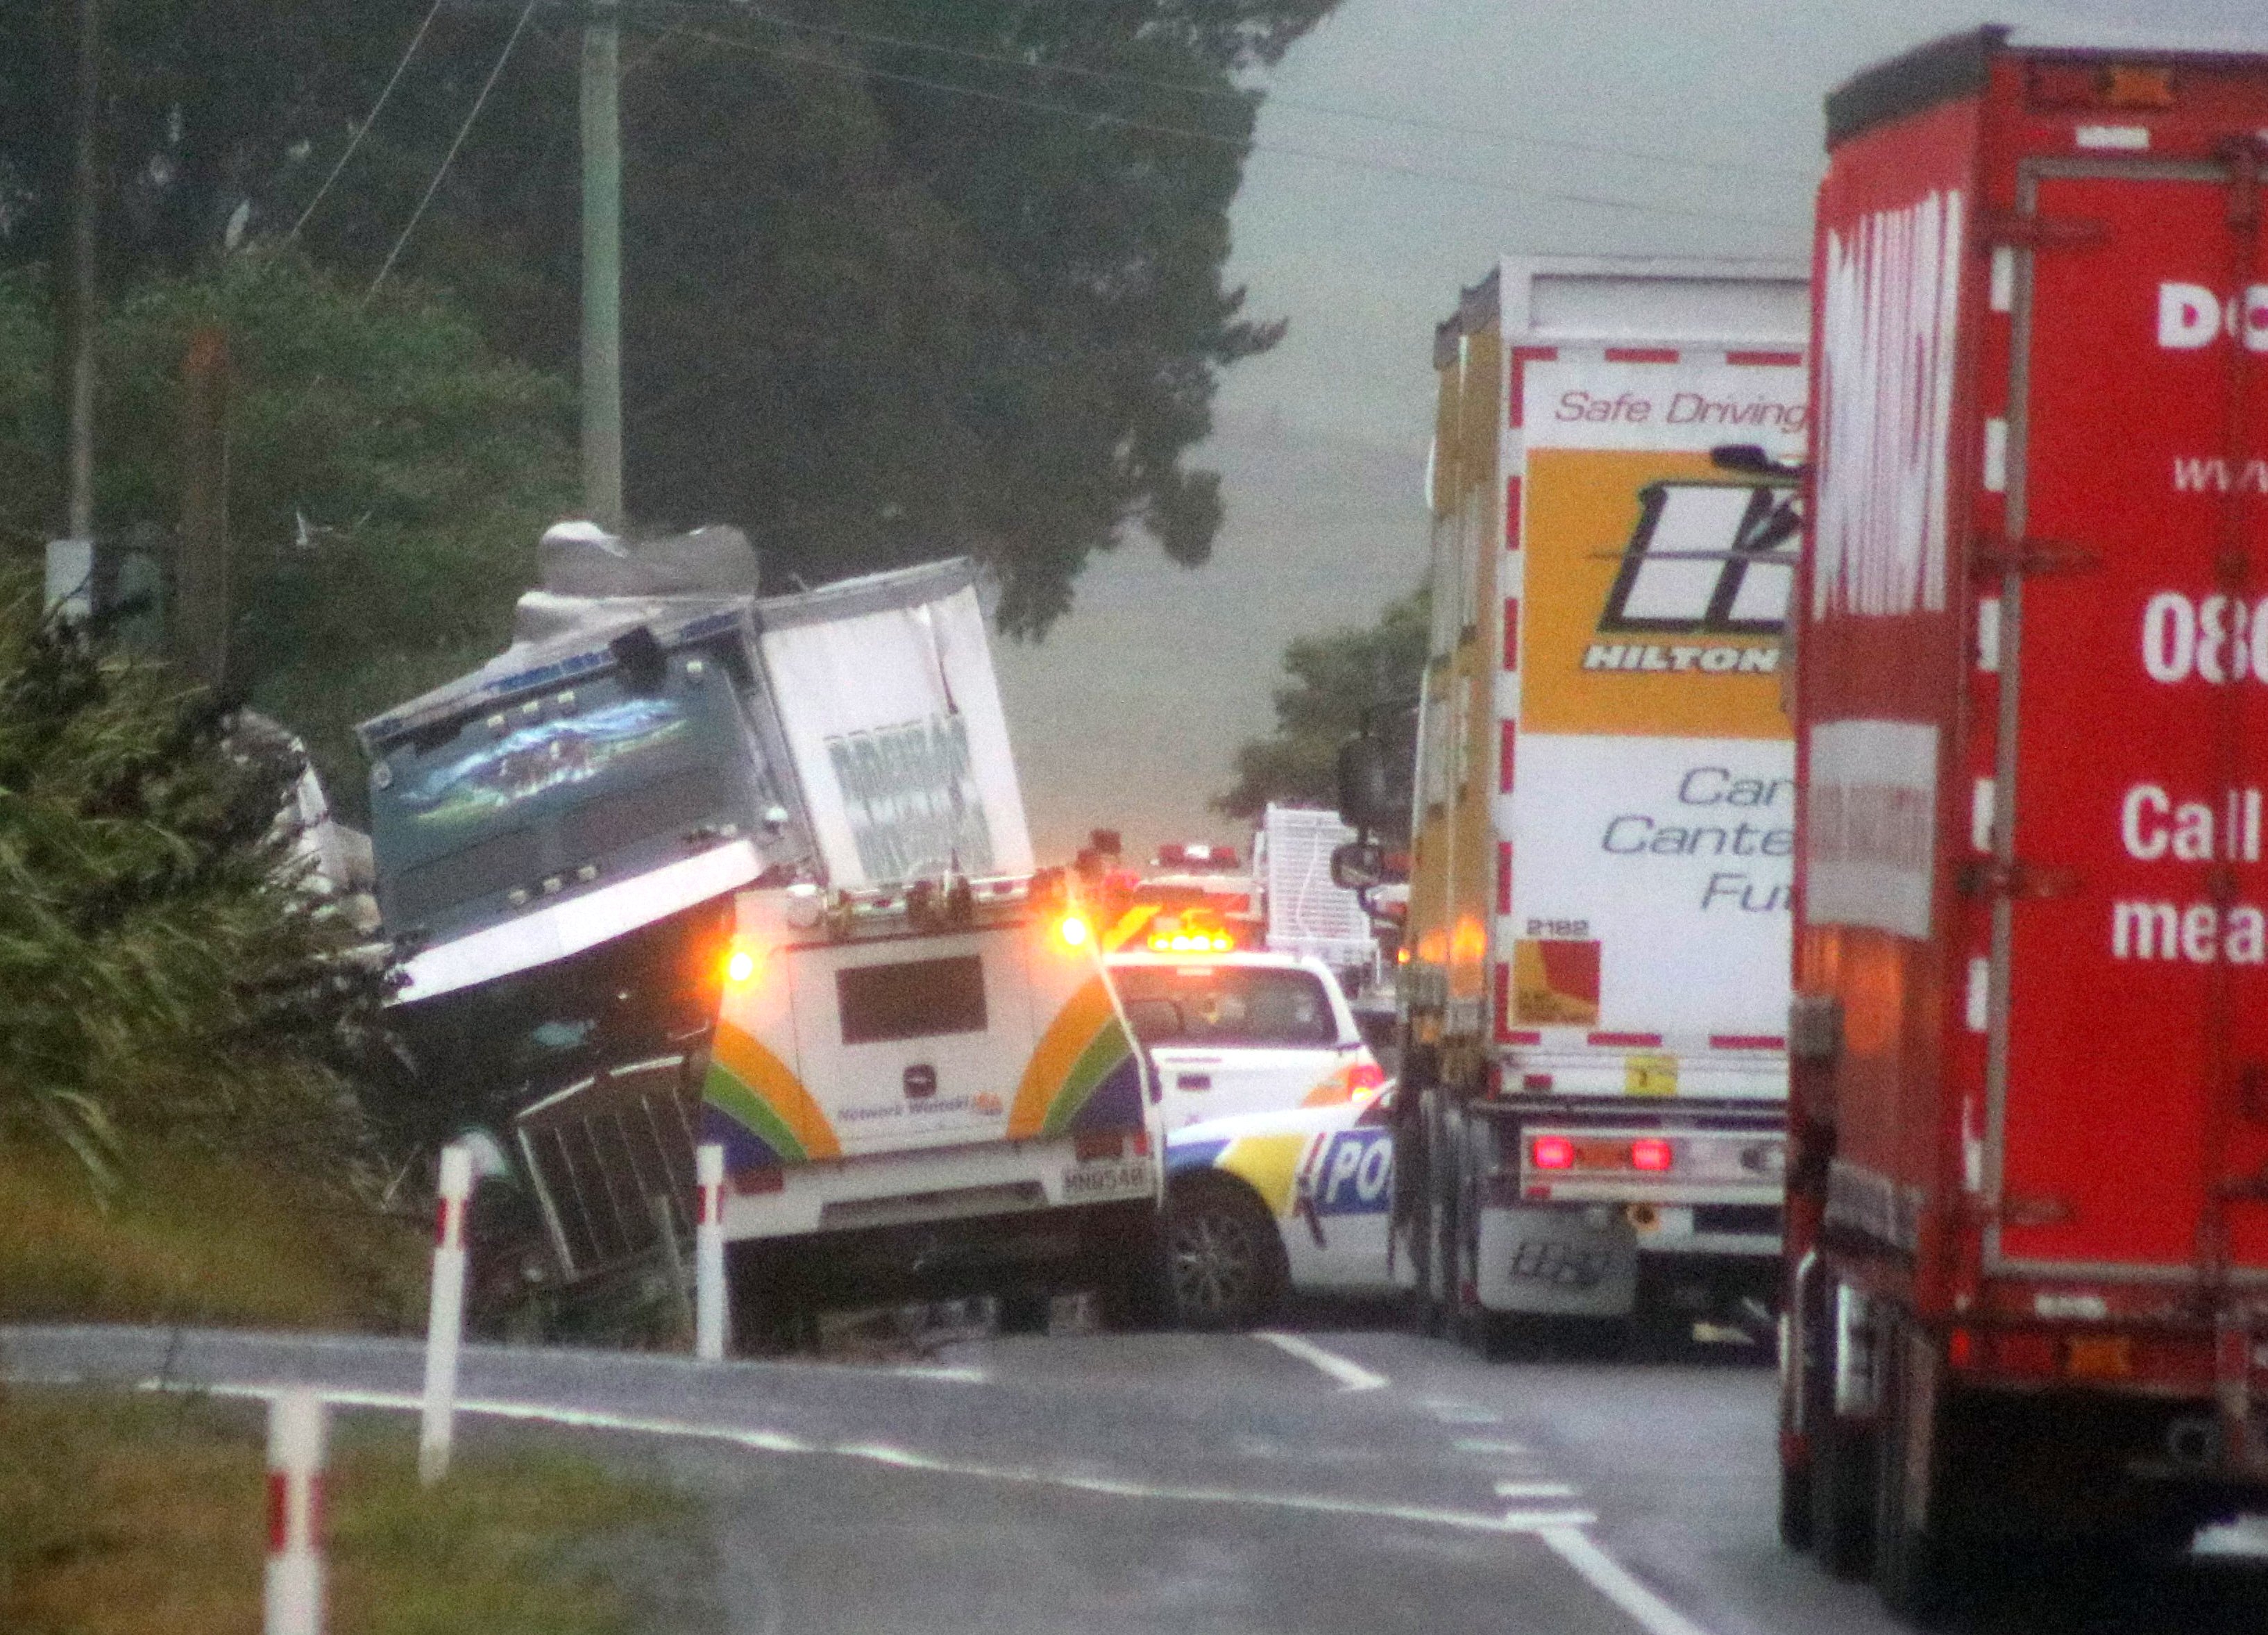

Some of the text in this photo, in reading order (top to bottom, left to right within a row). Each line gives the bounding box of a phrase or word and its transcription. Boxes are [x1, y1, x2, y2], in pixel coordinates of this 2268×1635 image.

[1555, 391, 1807, 434] Safe Driving
[1582, 644, 1781, 673] HILTON
[2143, 593, 2268, 684] 08
[2122, 784, 2262, 862] Call
[1700, 872, 1792, 912] Fu
